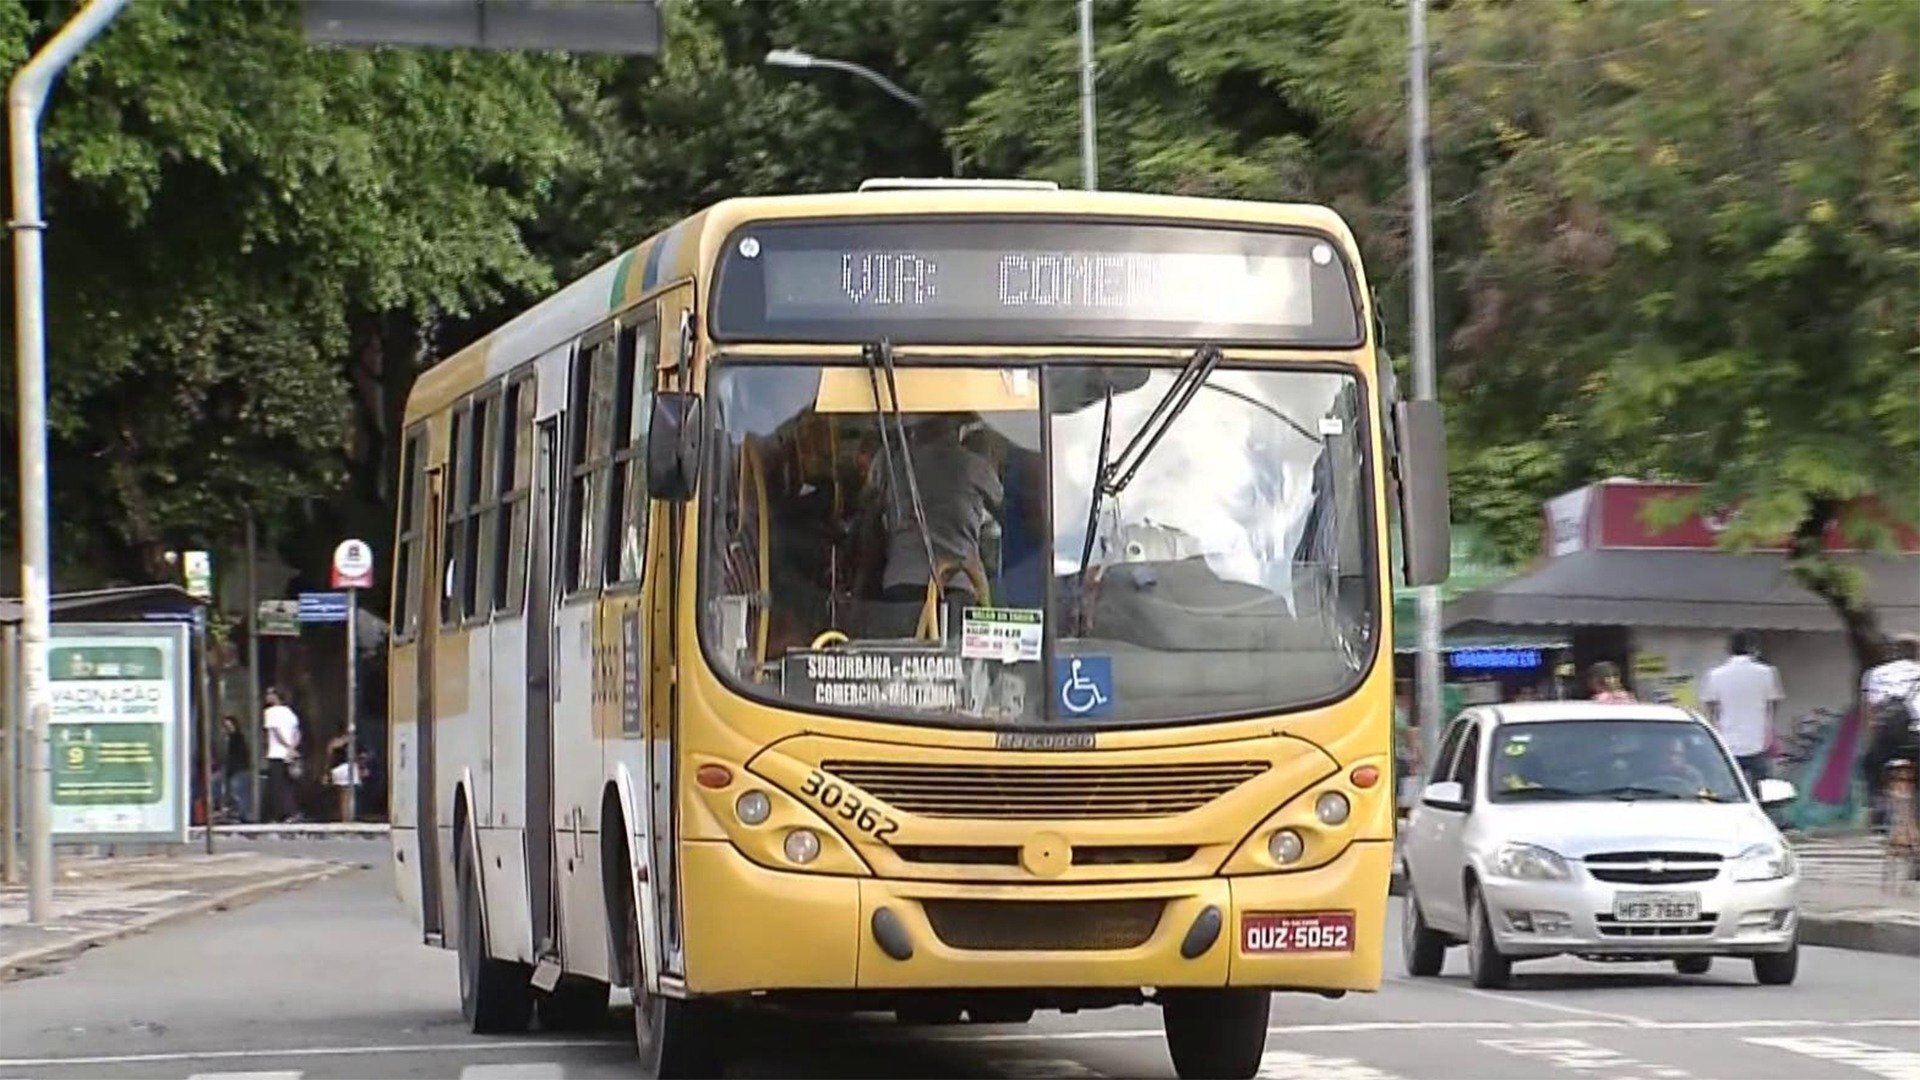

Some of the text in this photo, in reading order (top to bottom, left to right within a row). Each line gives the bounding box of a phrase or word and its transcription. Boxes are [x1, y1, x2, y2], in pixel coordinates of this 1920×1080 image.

[843, 254, 936, 304] VIA:
[807, 653, 892, 679] SUBURBANA
[815, 682, 880, 706] COMERCIO
[801, 769, 900, 846] 30362
